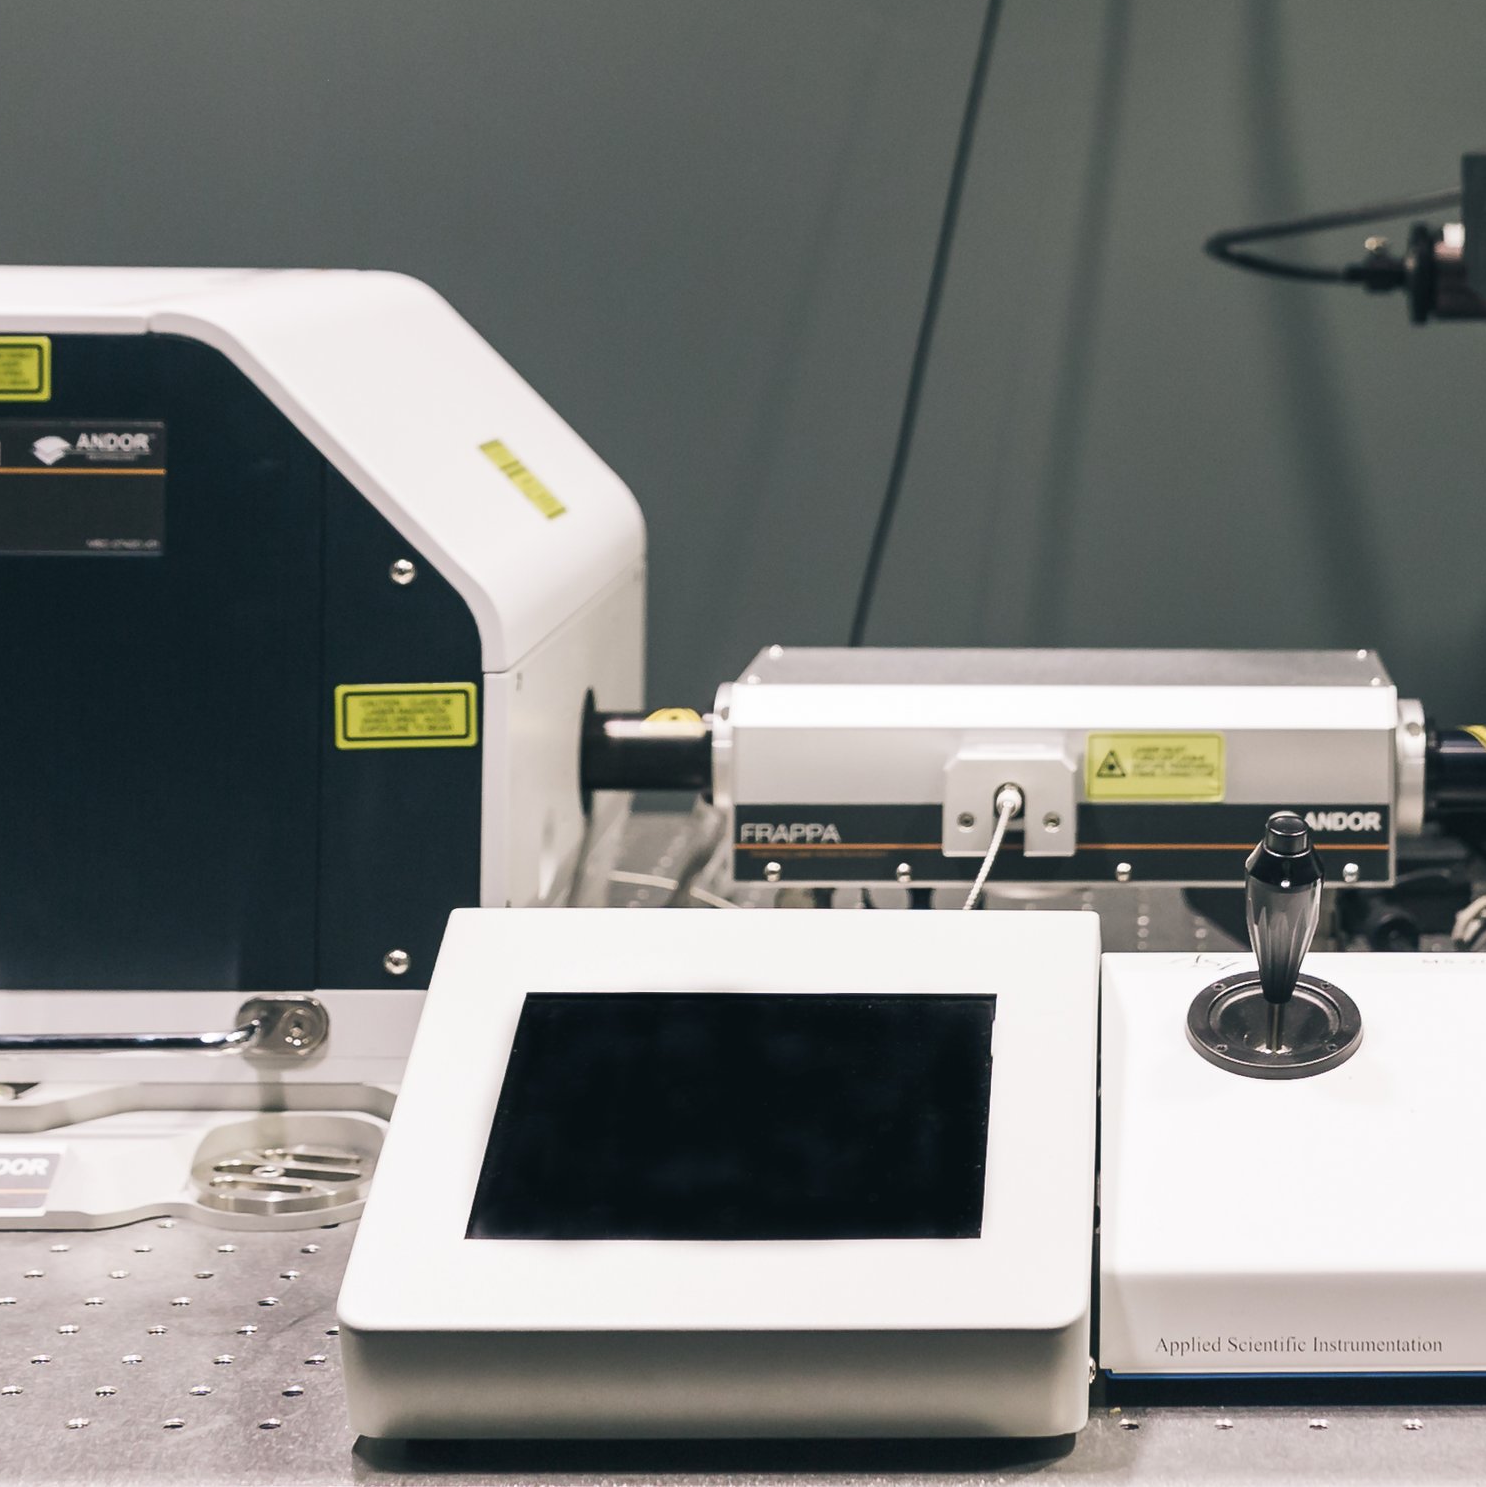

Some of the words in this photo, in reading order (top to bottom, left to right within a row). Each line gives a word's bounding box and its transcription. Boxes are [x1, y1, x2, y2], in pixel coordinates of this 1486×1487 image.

[75, 433, 149, 450] ANDOR
[1305, 811, 1381, 831] ANDOR
[741, 823, 842, 844] FRAPPA
[1155, 1337, 1221, 1356] Applied
[1228, 1336, 1306, 1353] Scientific
[1313, 1337, 1443, 1353] Instrumentation
